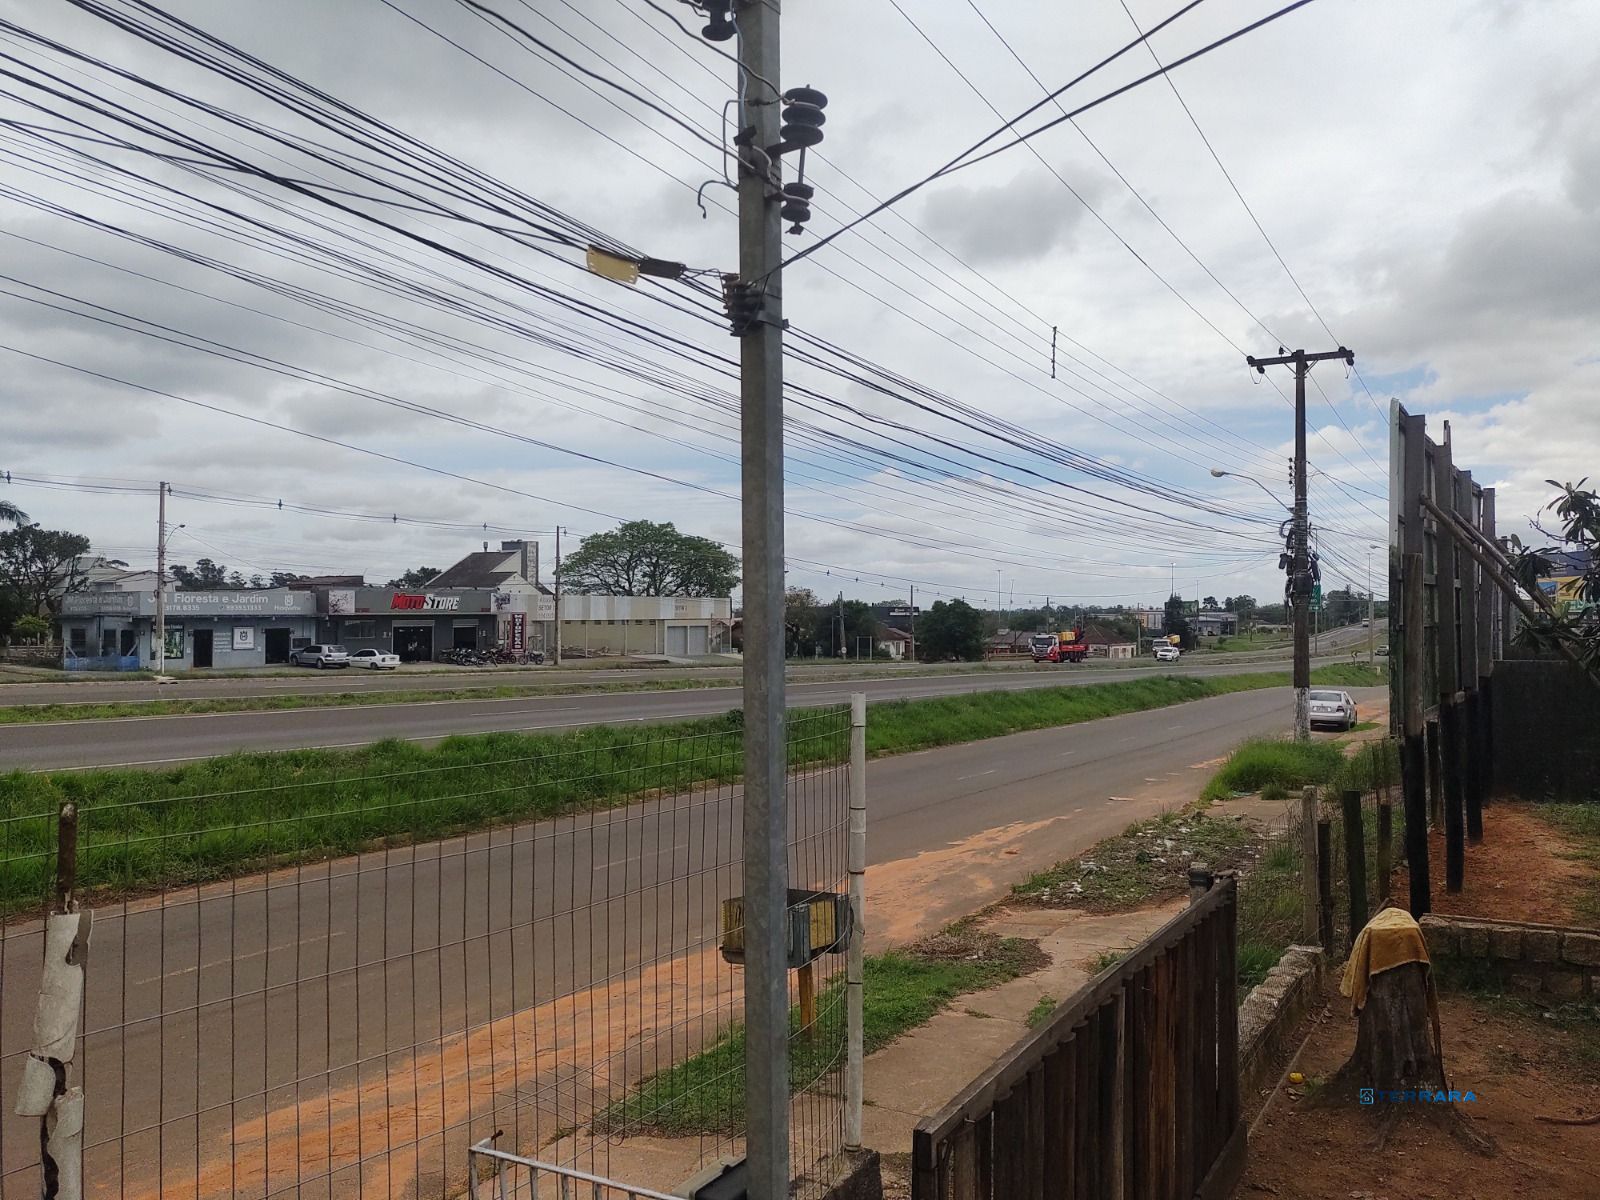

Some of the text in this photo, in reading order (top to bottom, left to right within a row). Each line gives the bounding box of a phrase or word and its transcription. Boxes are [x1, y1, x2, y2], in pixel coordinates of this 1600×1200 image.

[174, 593, 219, 603] Floresta
[222, 595, 229, 603] e
[231, 593, 269, 604] Jardim
